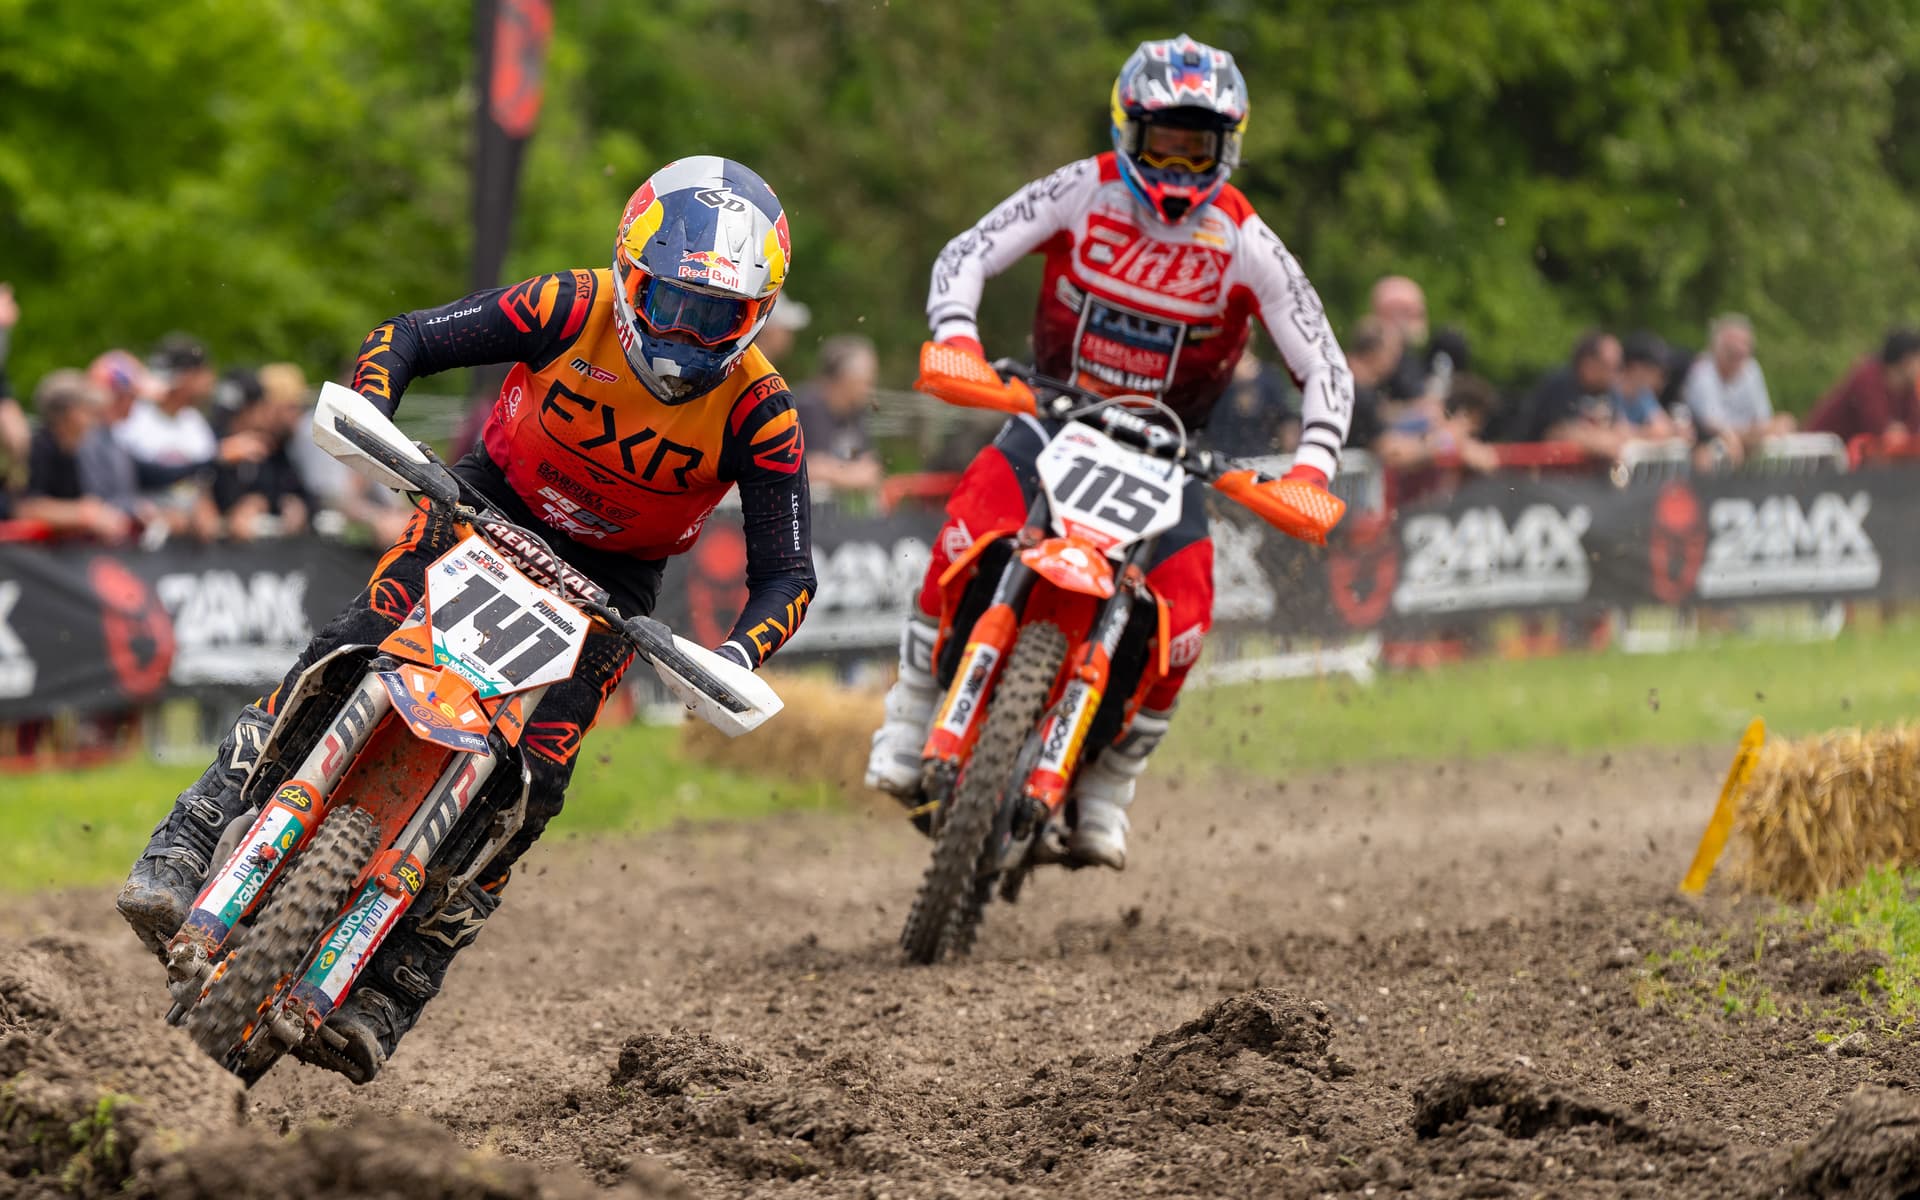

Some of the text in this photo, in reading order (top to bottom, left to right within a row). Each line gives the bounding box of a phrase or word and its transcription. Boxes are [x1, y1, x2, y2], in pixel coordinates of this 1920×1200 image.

[694, 188, 747, 212] 6D
[575, 273, 593, 300] FXR
[678, 266, 740, 289] Red Bull
[426, 305, 482, 325] PRO-FIT
[752, 378, 783, 401] FXR
[541, 379, 704, 489] FXR
[1053, 455, 1171, 534] 115
[791, 492, 801, 551] PRO-FIT
[485, 523, 597, 602] RENTHAL
[431, 573, 571, 687] 141
[532, 600, 577, 636] PURDON
[393, 637, 427, 654] KTM
[449, 658, 491, 693] MOTOREX
[280, 788, 310, 808] sbs
[398, 866, 420, 892] sbs
[358, 899, 389, 939] MODU
